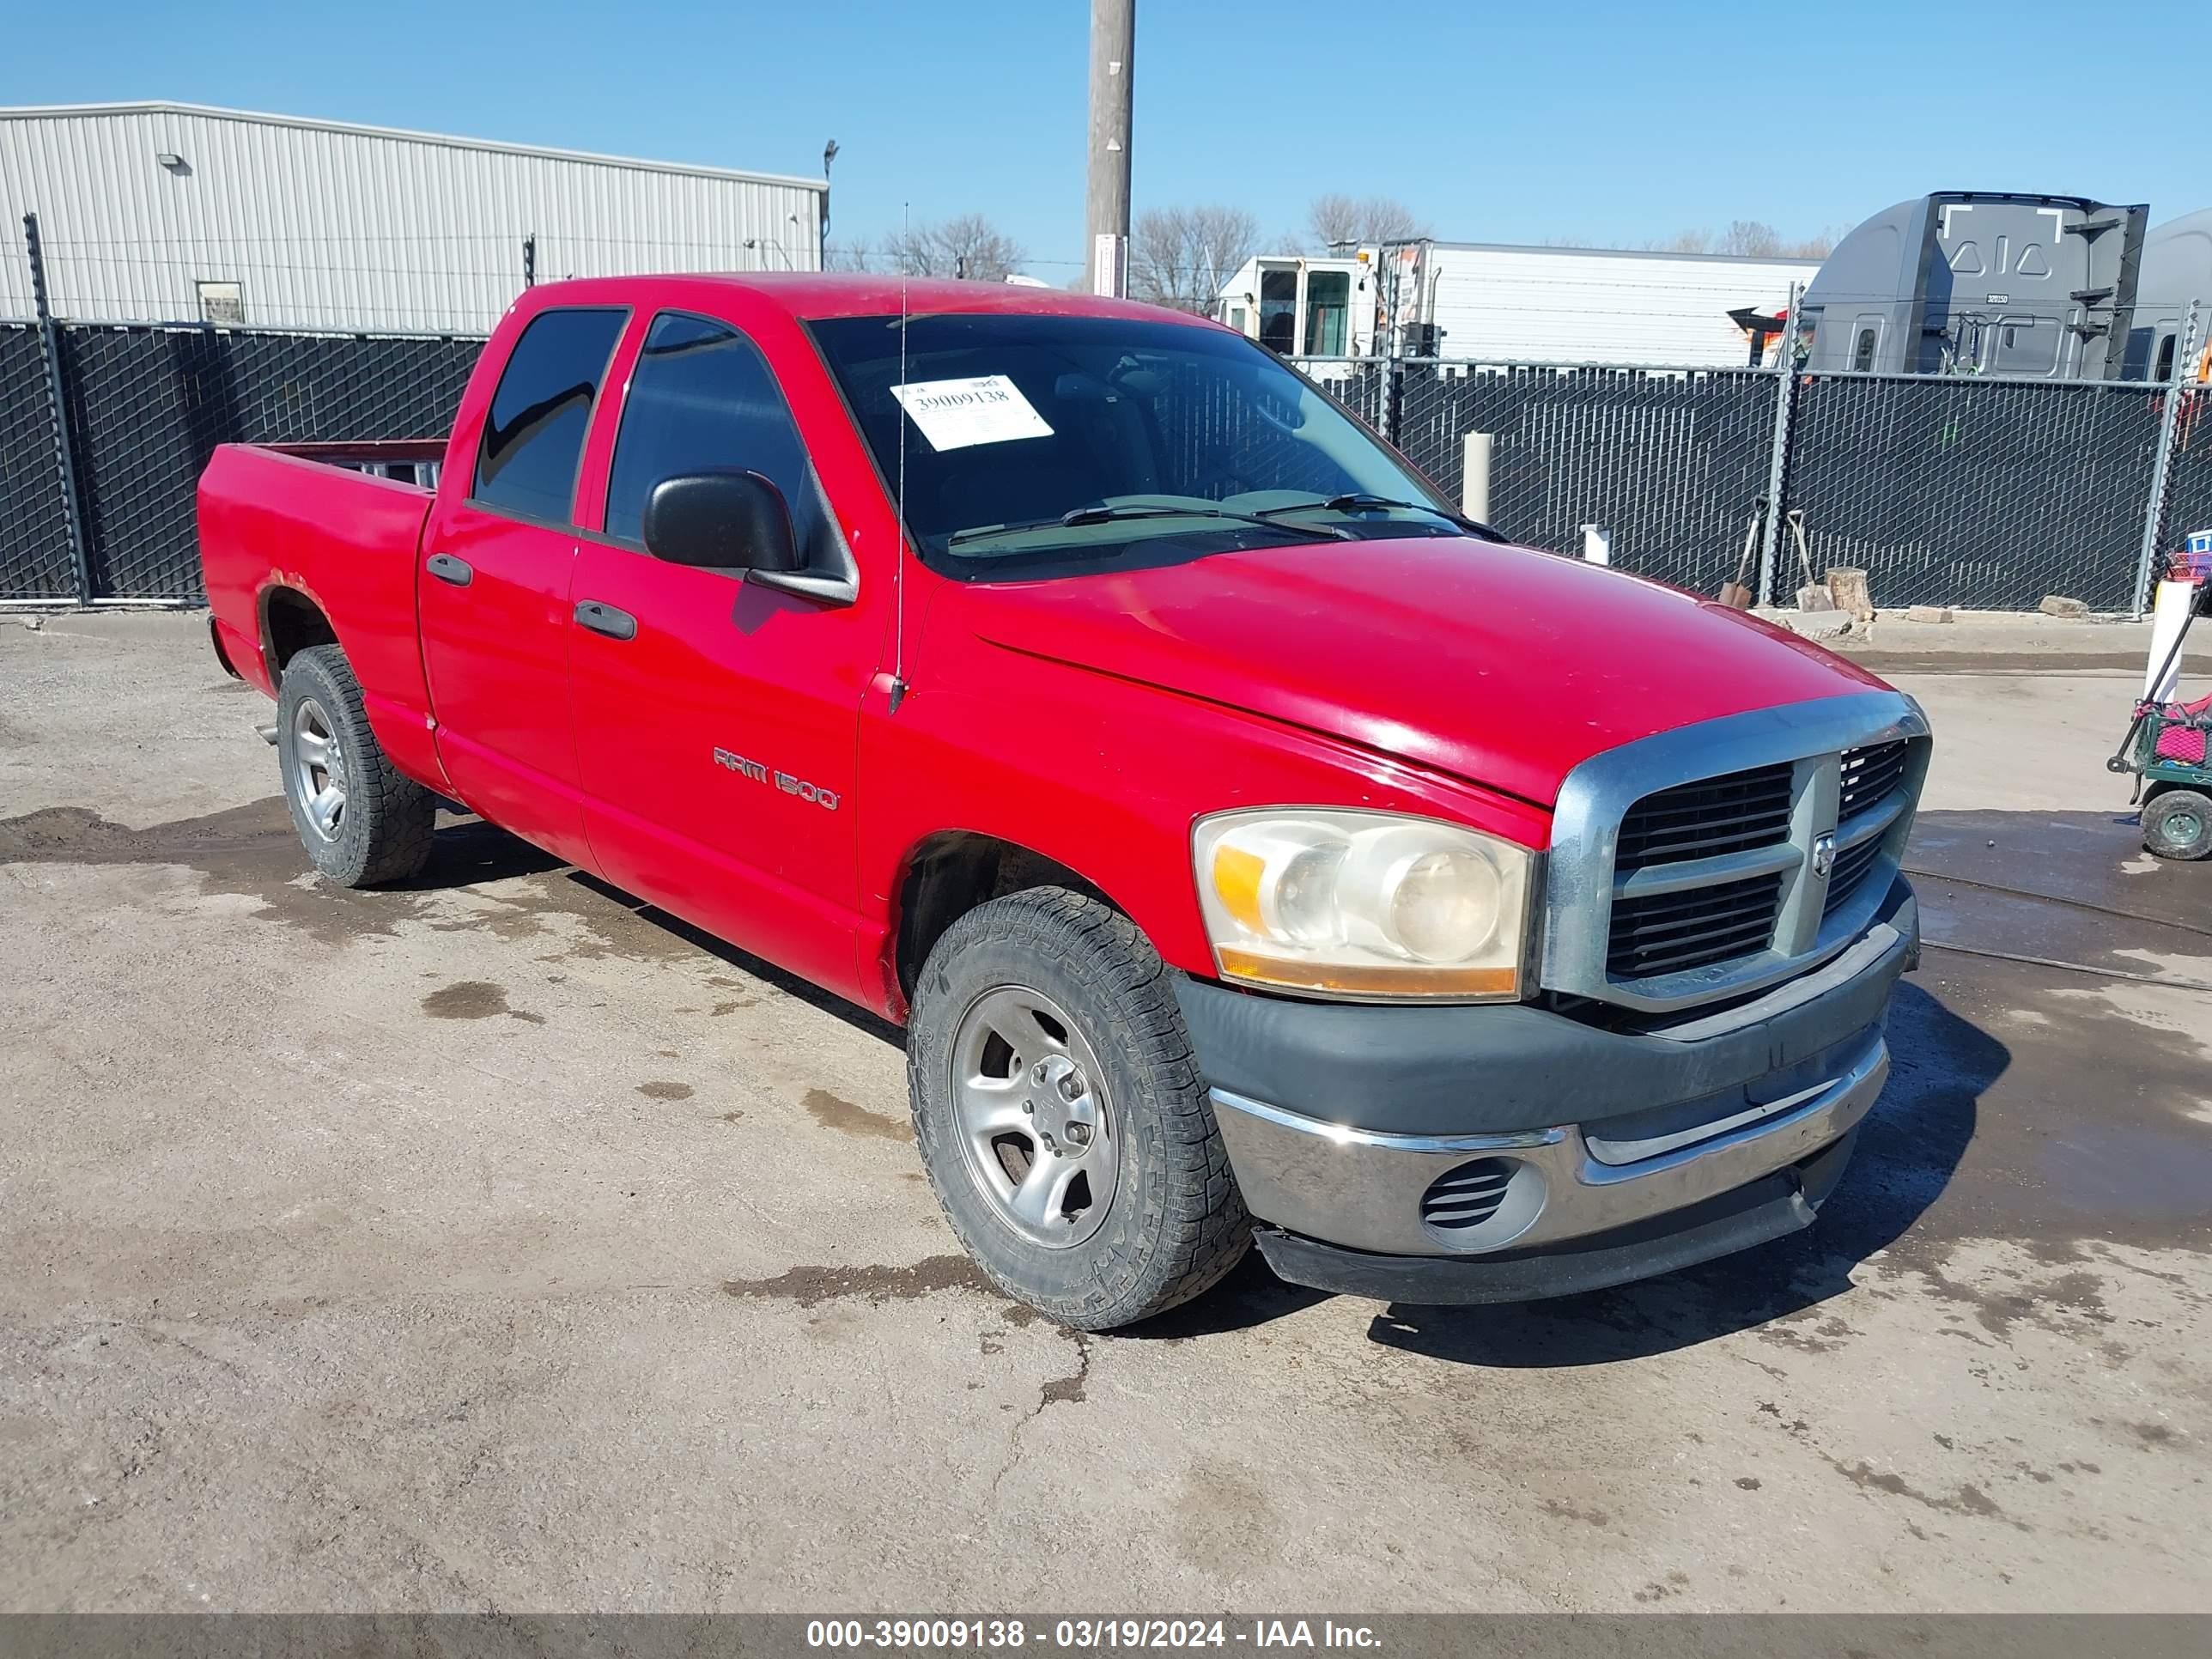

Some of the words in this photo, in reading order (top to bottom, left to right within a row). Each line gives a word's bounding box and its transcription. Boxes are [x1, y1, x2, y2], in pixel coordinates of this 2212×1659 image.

[915, 390, 1010, 411] 39009138
[714, 746, 768, 784] RAM
[773, 769, 838, 811] 1500
